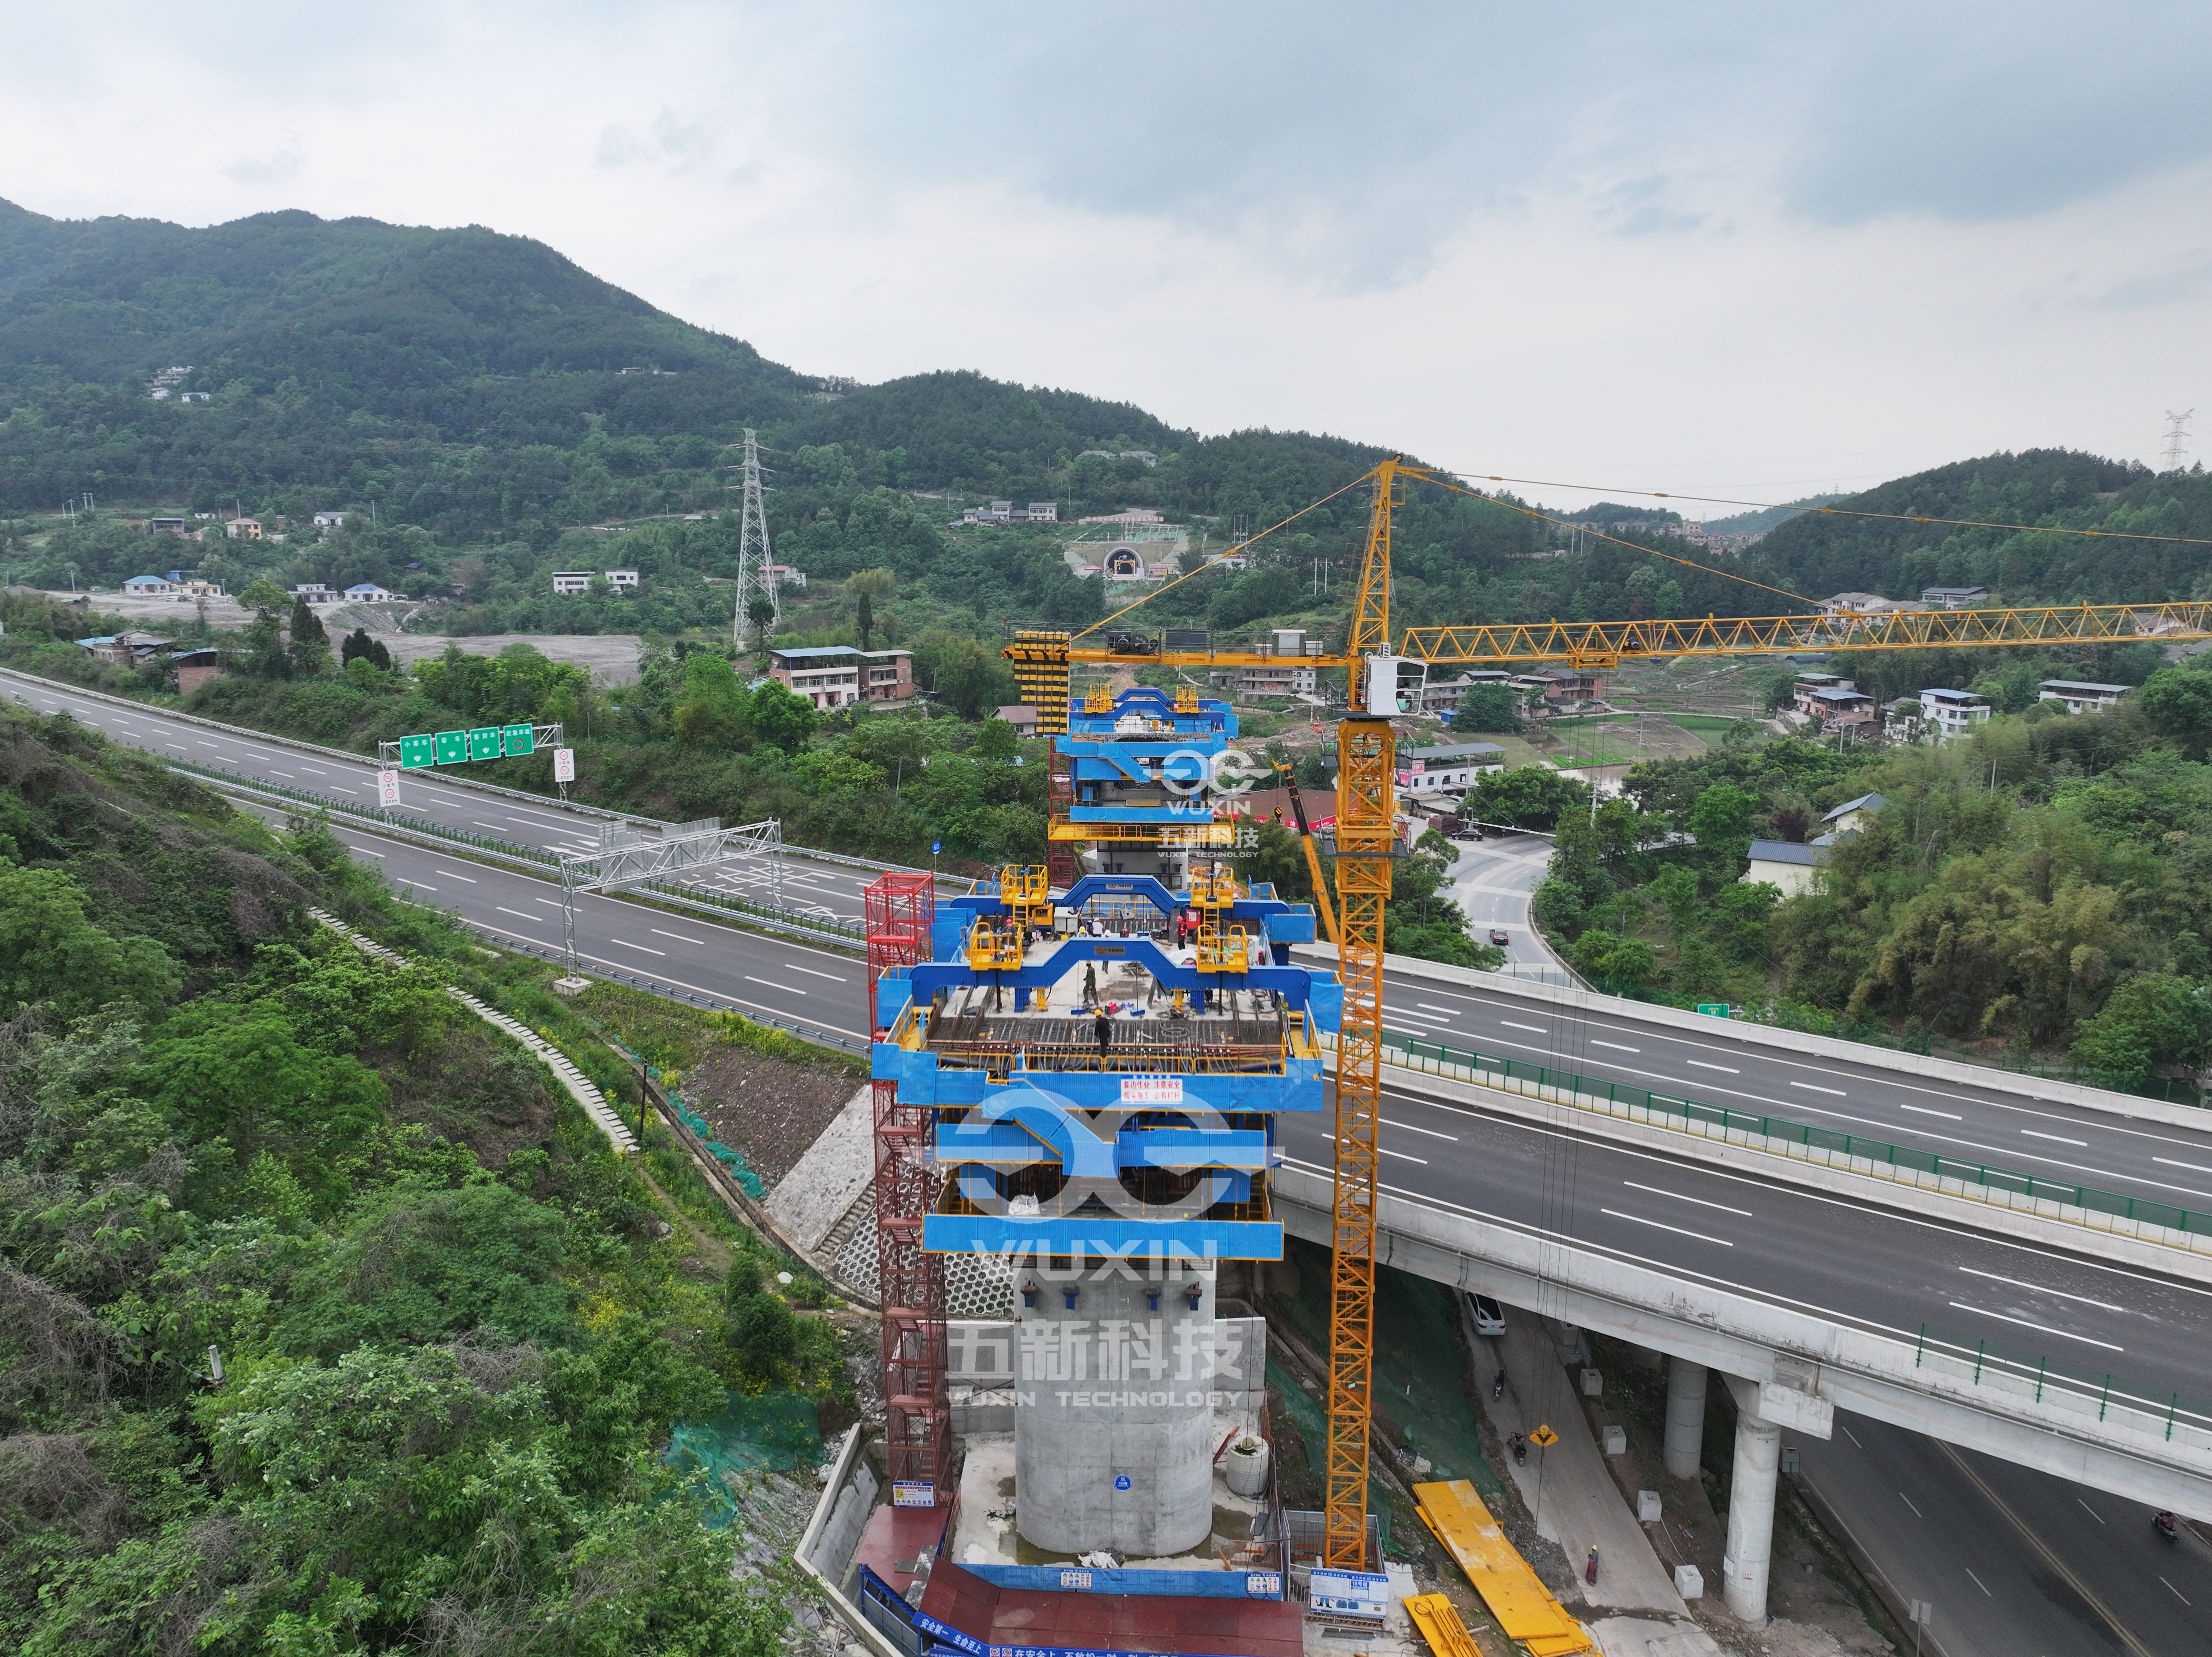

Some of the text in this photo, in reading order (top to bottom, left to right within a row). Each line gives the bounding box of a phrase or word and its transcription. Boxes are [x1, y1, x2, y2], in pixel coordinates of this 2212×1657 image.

[404, 739, 428, 748] 小客车
[1124, 1081, 1179, 1089] 临边作业 注意安全
[920, 1618, 948, 1635] 安全第一
[953, 1634, 982, 1654] 生命至上
